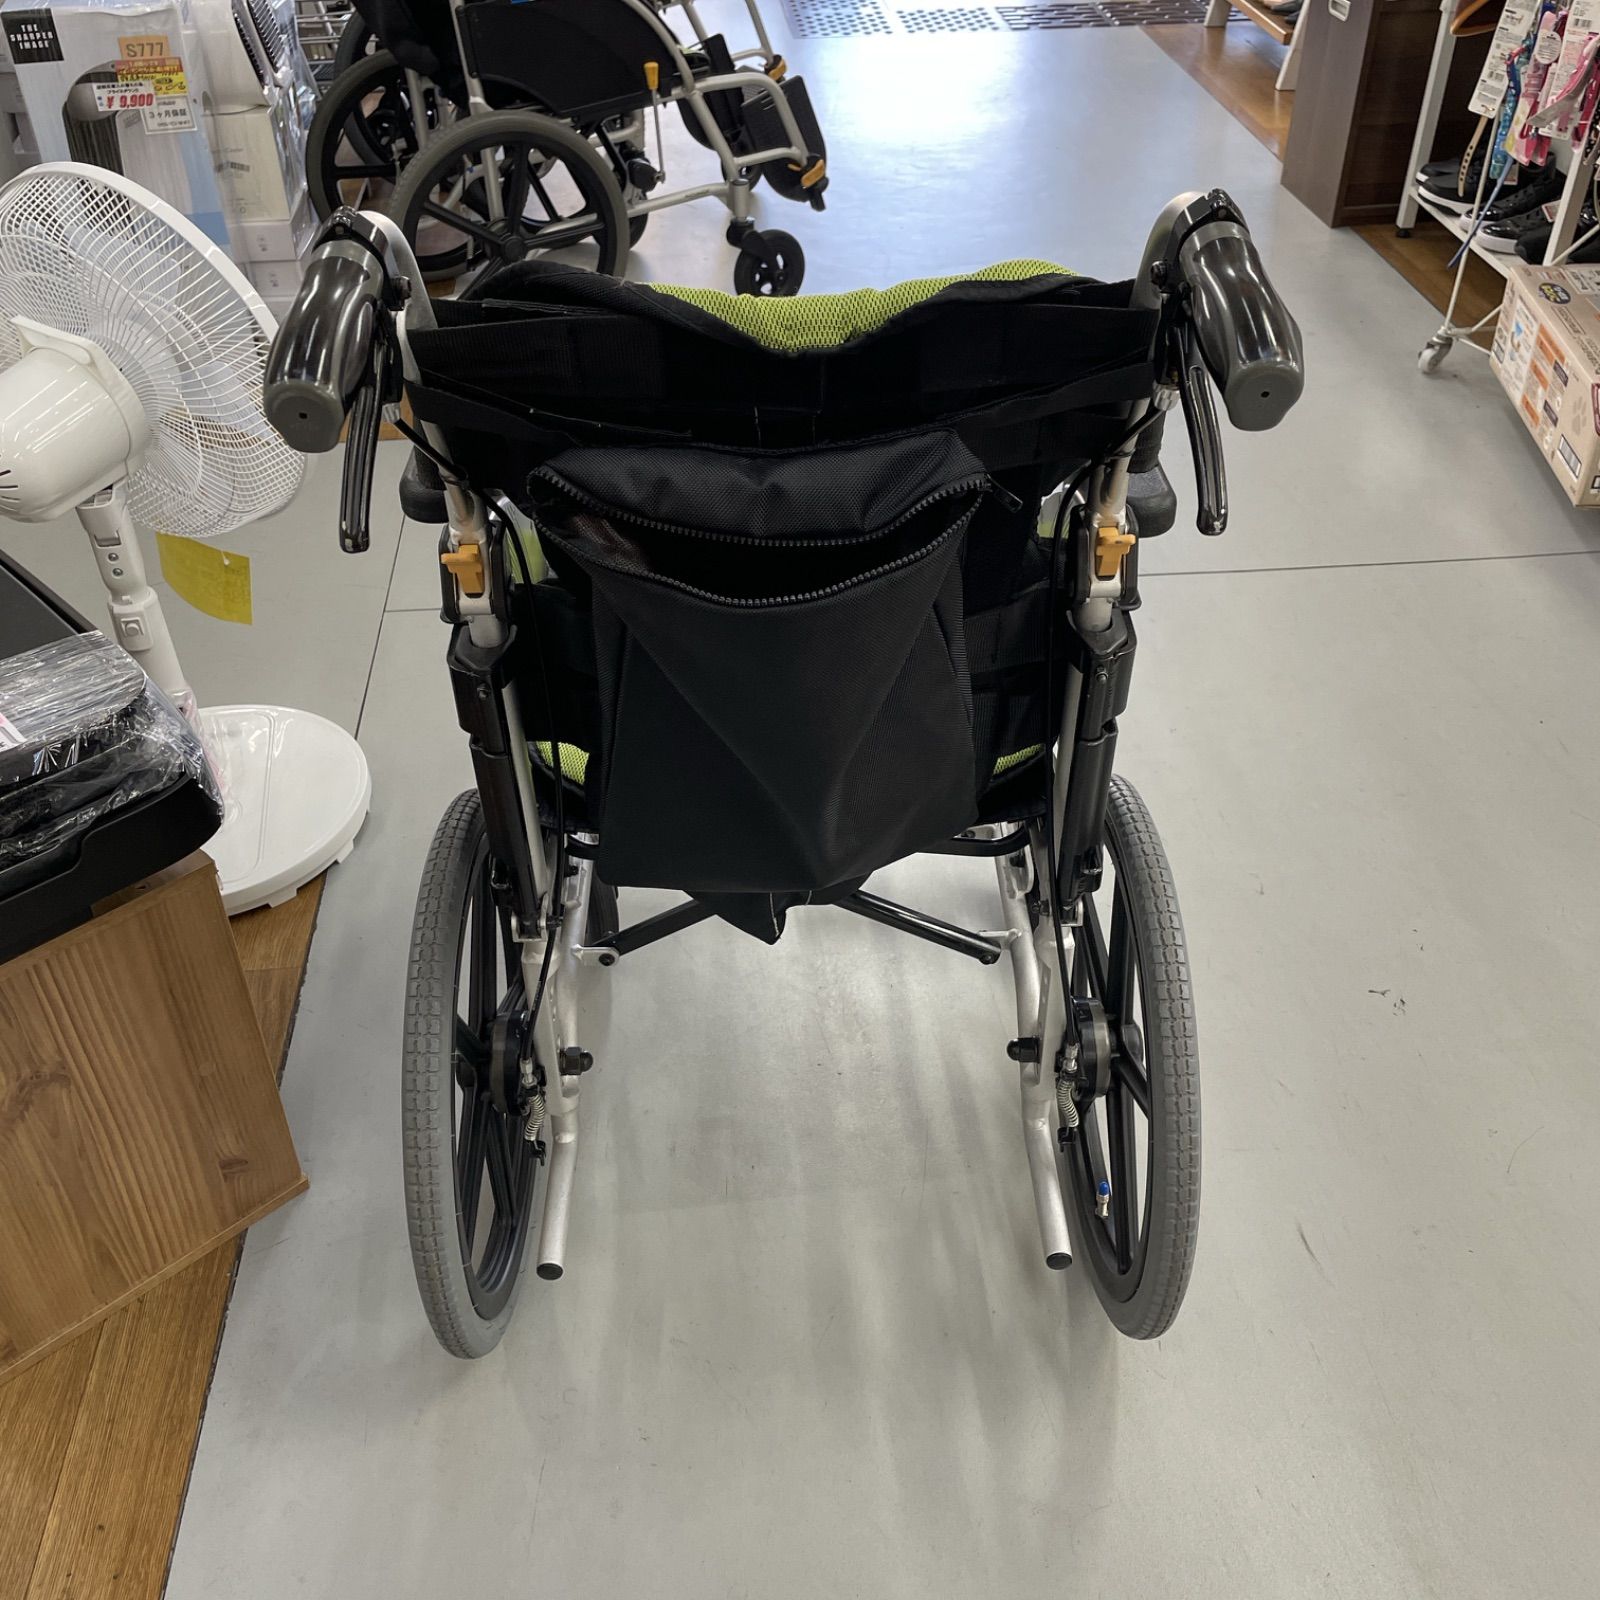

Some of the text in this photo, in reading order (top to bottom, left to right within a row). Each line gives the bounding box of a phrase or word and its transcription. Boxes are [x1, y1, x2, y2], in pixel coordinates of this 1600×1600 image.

[21, 24, 38, 32] THE
[10, 31, 53, 42] SHARPER
[19, 40, 49, 50] IMAGE
[126, 42, 164, 58] S777
[119, 93, 154, 109] 9,900
